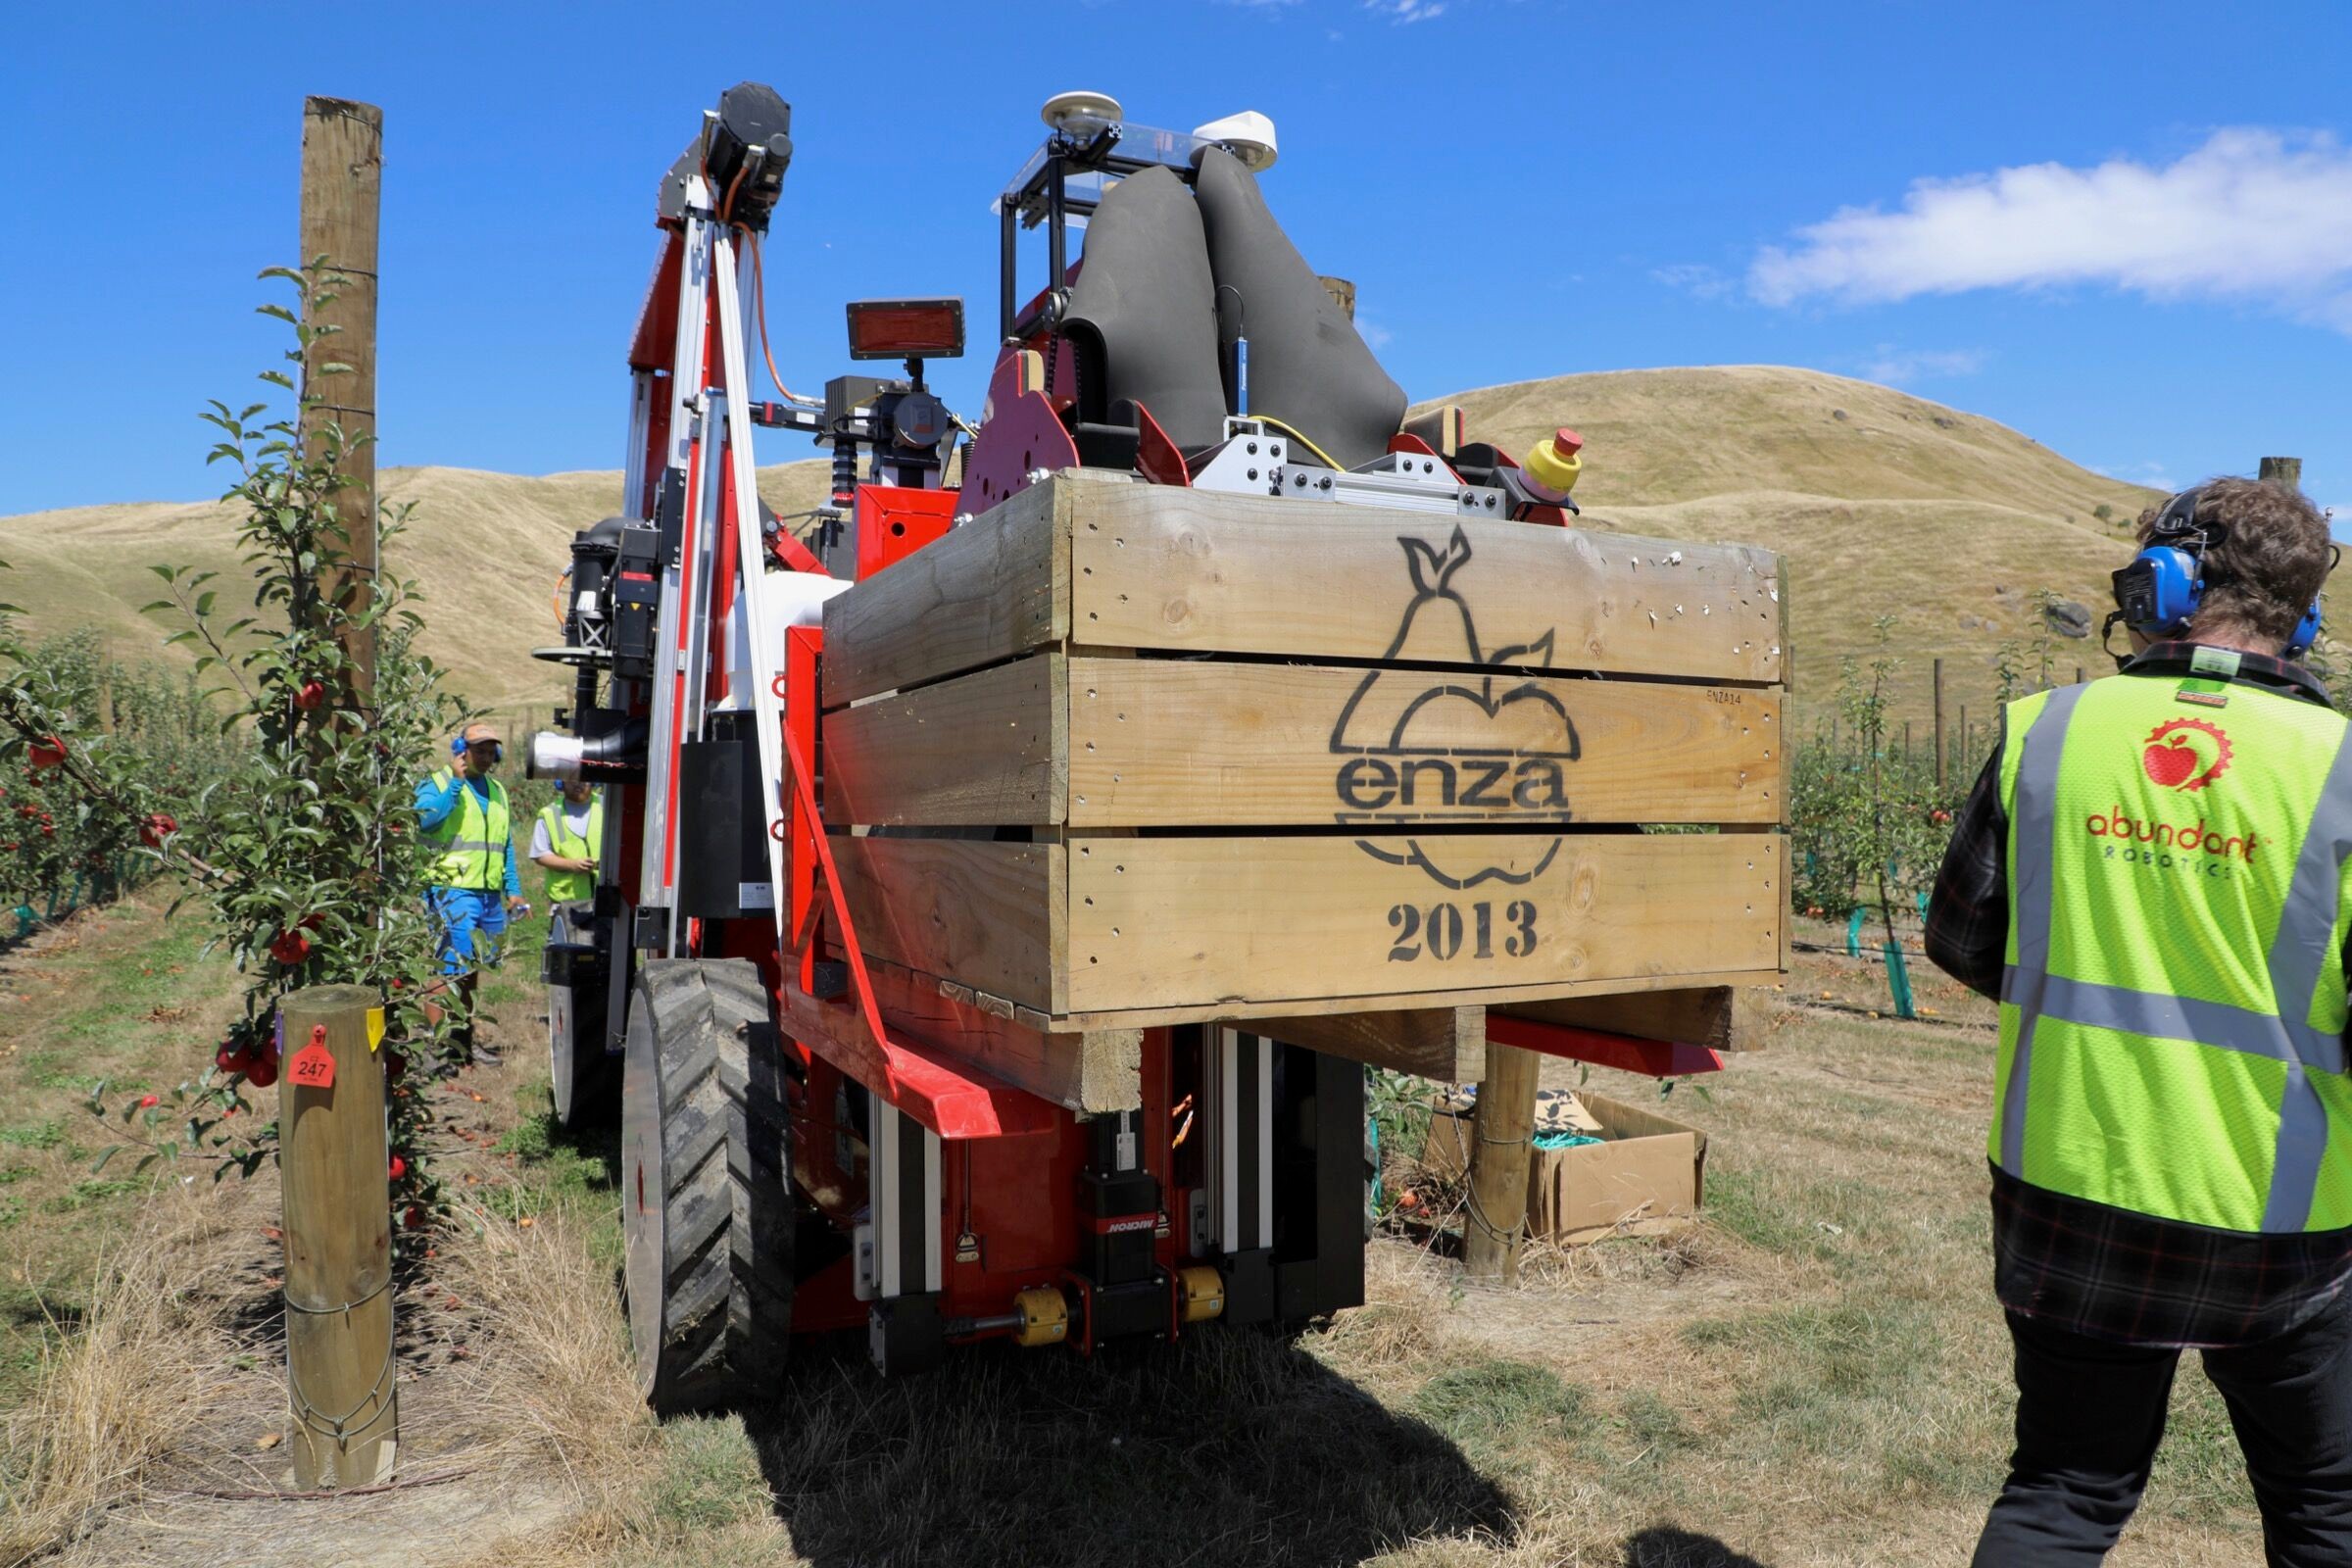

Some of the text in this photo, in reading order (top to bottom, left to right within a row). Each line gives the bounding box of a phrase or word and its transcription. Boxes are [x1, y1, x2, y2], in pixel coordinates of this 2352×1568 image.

[1336, 759, 1568, 808] enza
[2086, 805, 2257, 863] abundant
[1388, 901, 1538, 962] 2013
[298, 1061, 326, 1077] 247
[1108, 1220, 1154, 1233] MICRON
